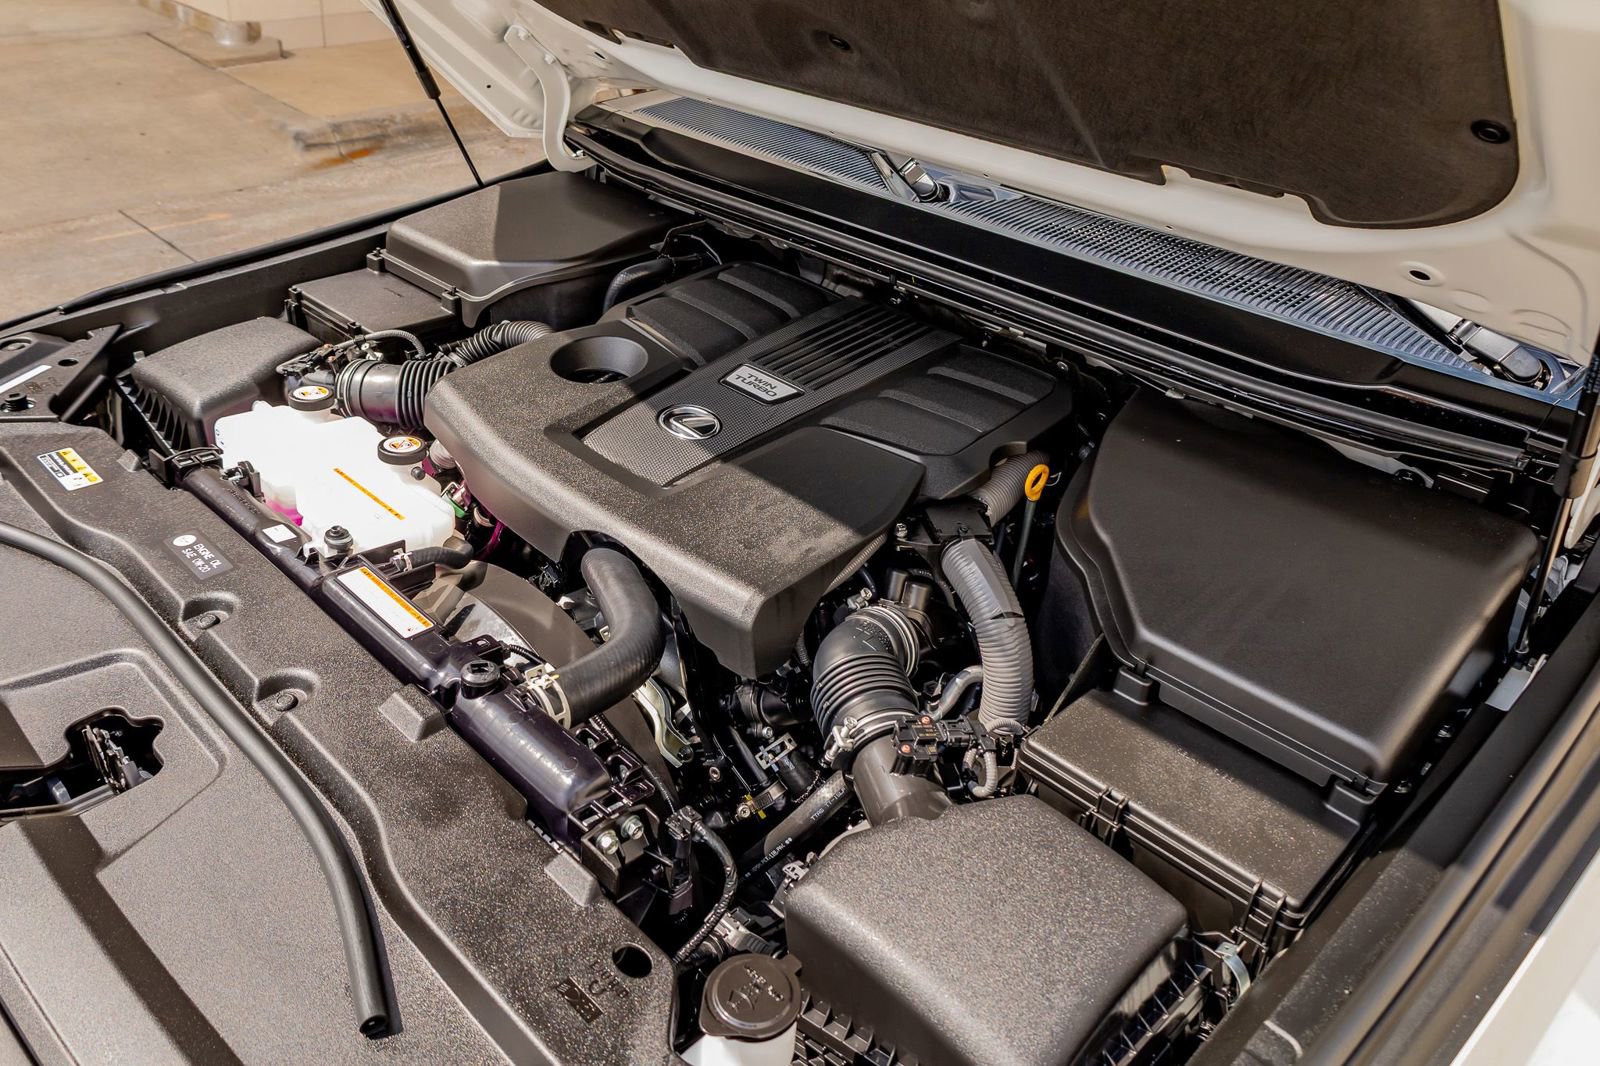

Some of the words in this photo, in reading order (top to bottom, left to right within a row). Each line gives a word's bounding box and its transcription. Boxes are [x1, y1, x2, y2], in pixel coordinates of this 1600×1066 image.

[735, 374, 777, 397] TURBO
[747, 373, 777, 390] TWIN
[181, 548, 197, 558] SAE
[193, 543, 214, 559] ENGINE
